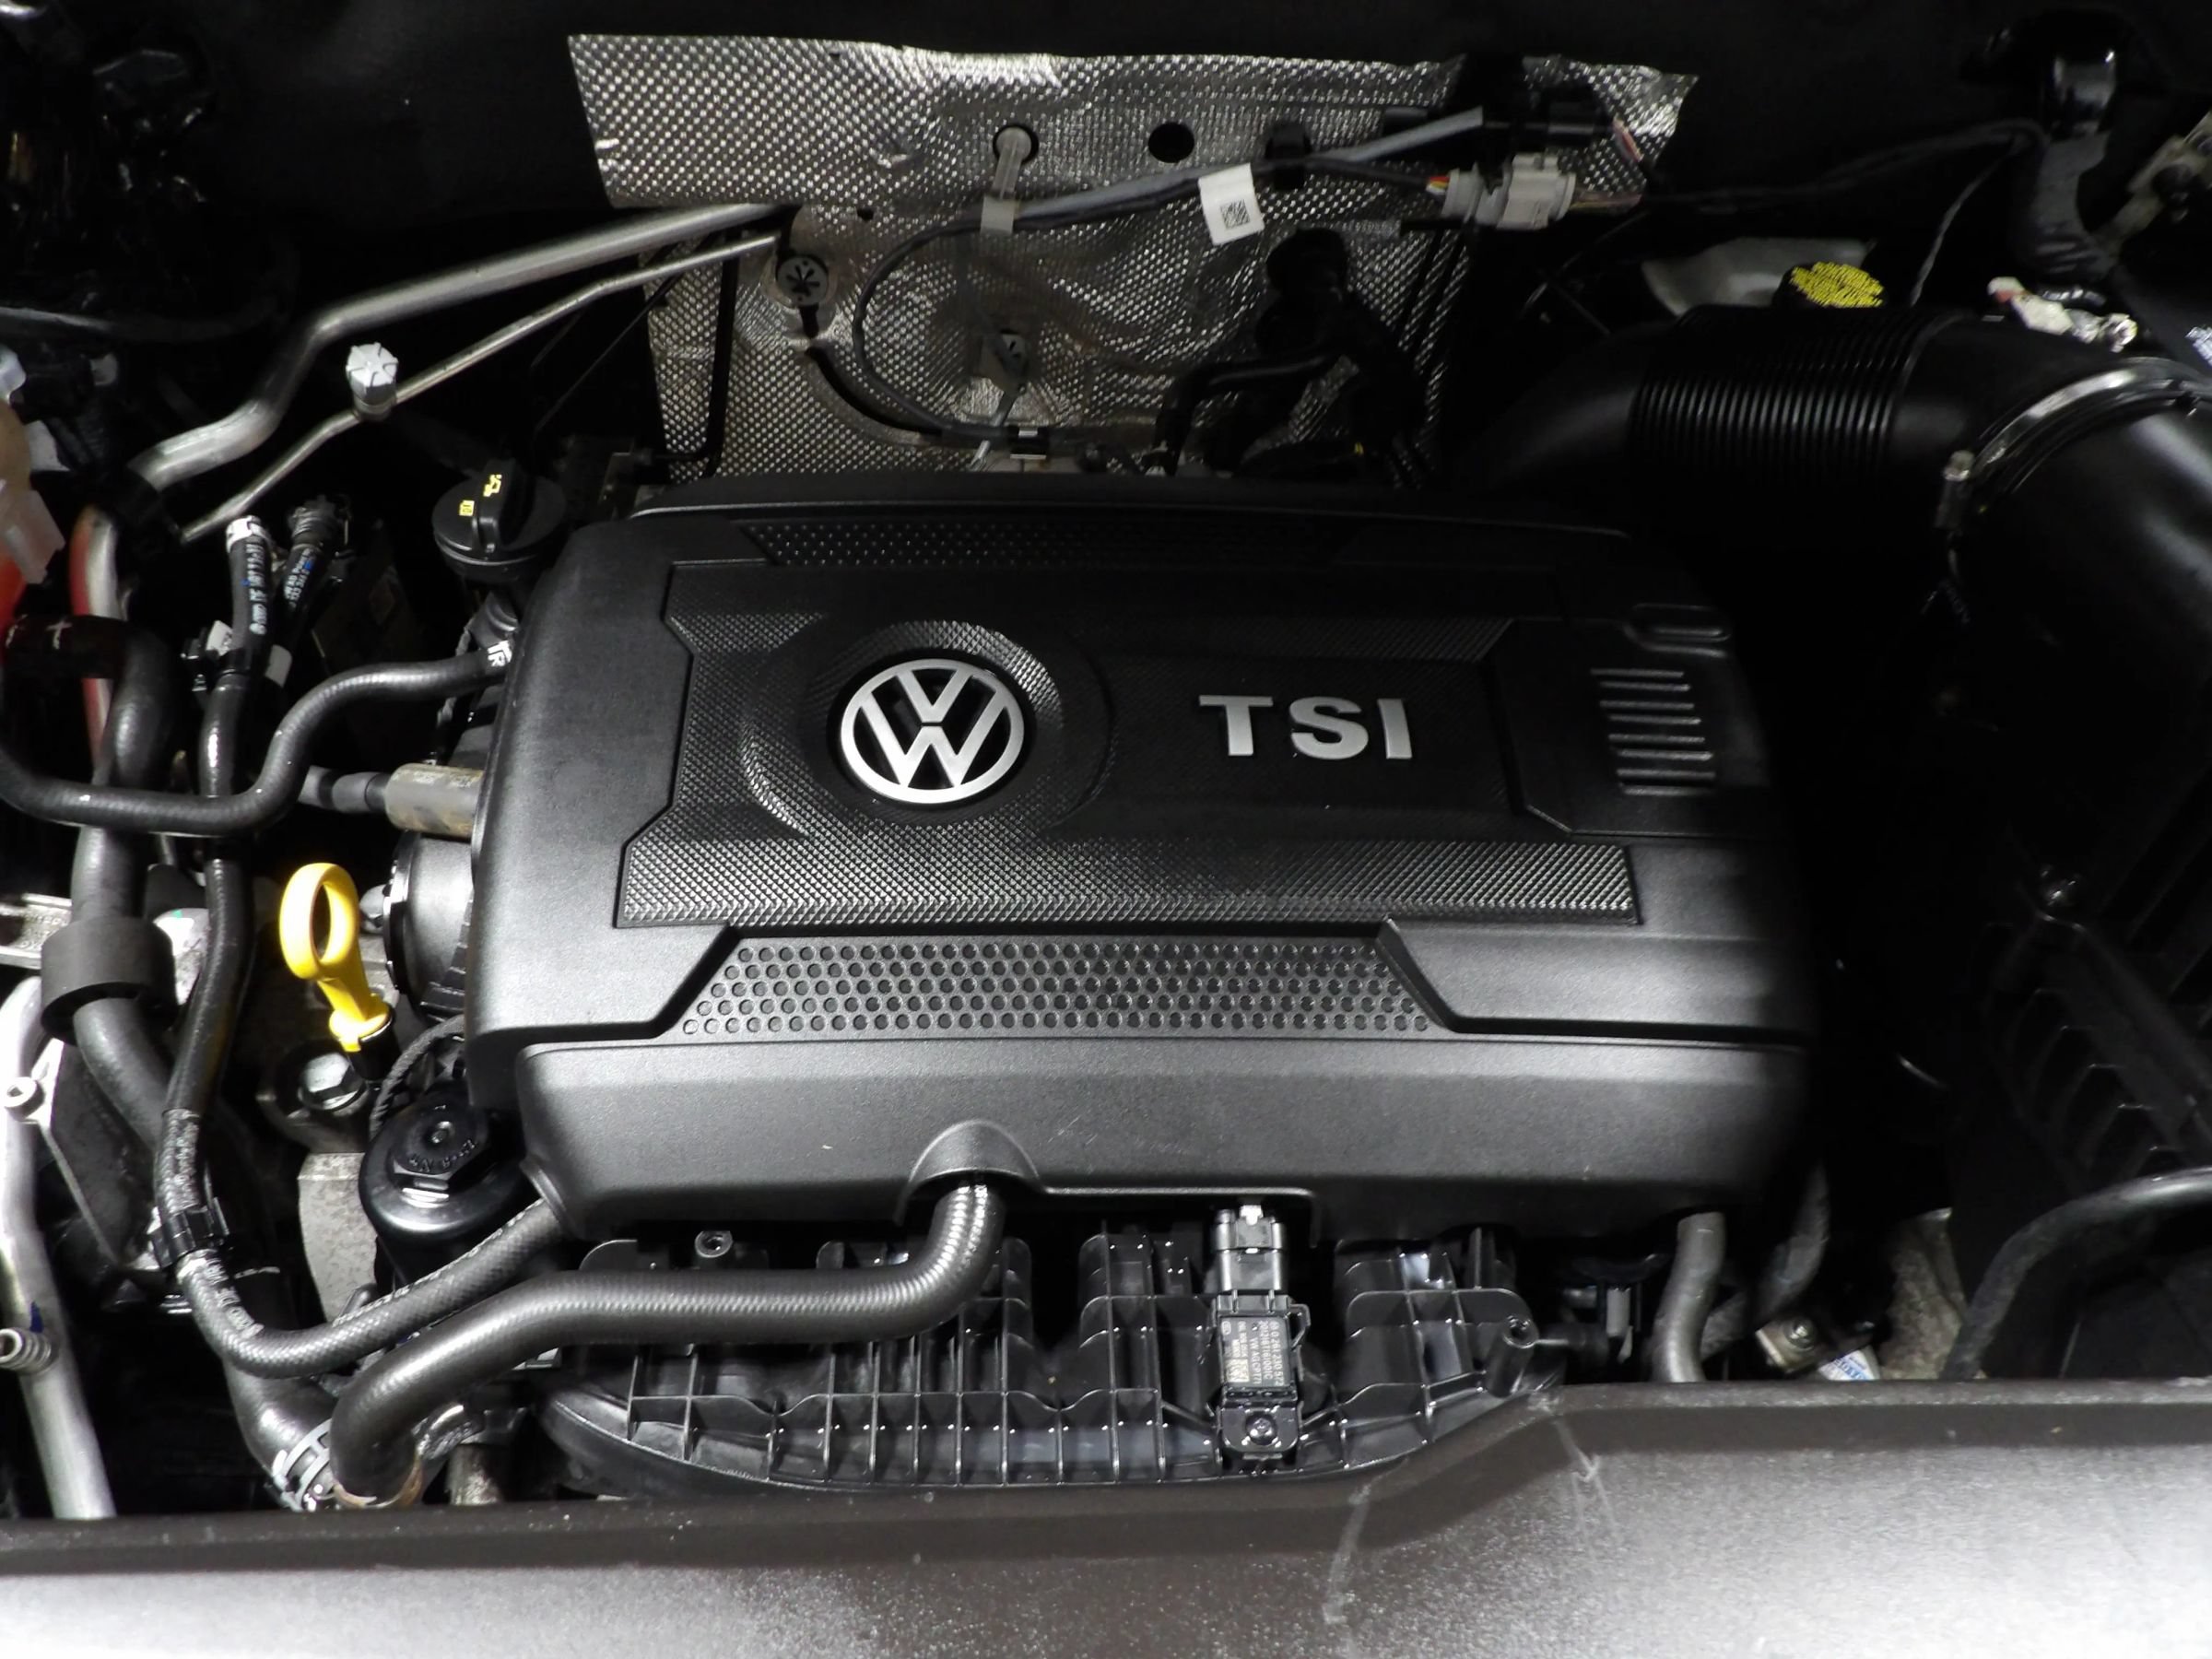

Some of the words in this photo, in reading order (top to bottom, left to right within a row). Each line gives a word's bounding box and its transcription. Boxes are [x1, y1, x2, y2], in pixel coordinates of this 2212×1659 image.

[841, 659, 1024, 804] VW
[1199, 694, 1412, 759] TSI
[1250, 1337, 1260, 1350] VW
